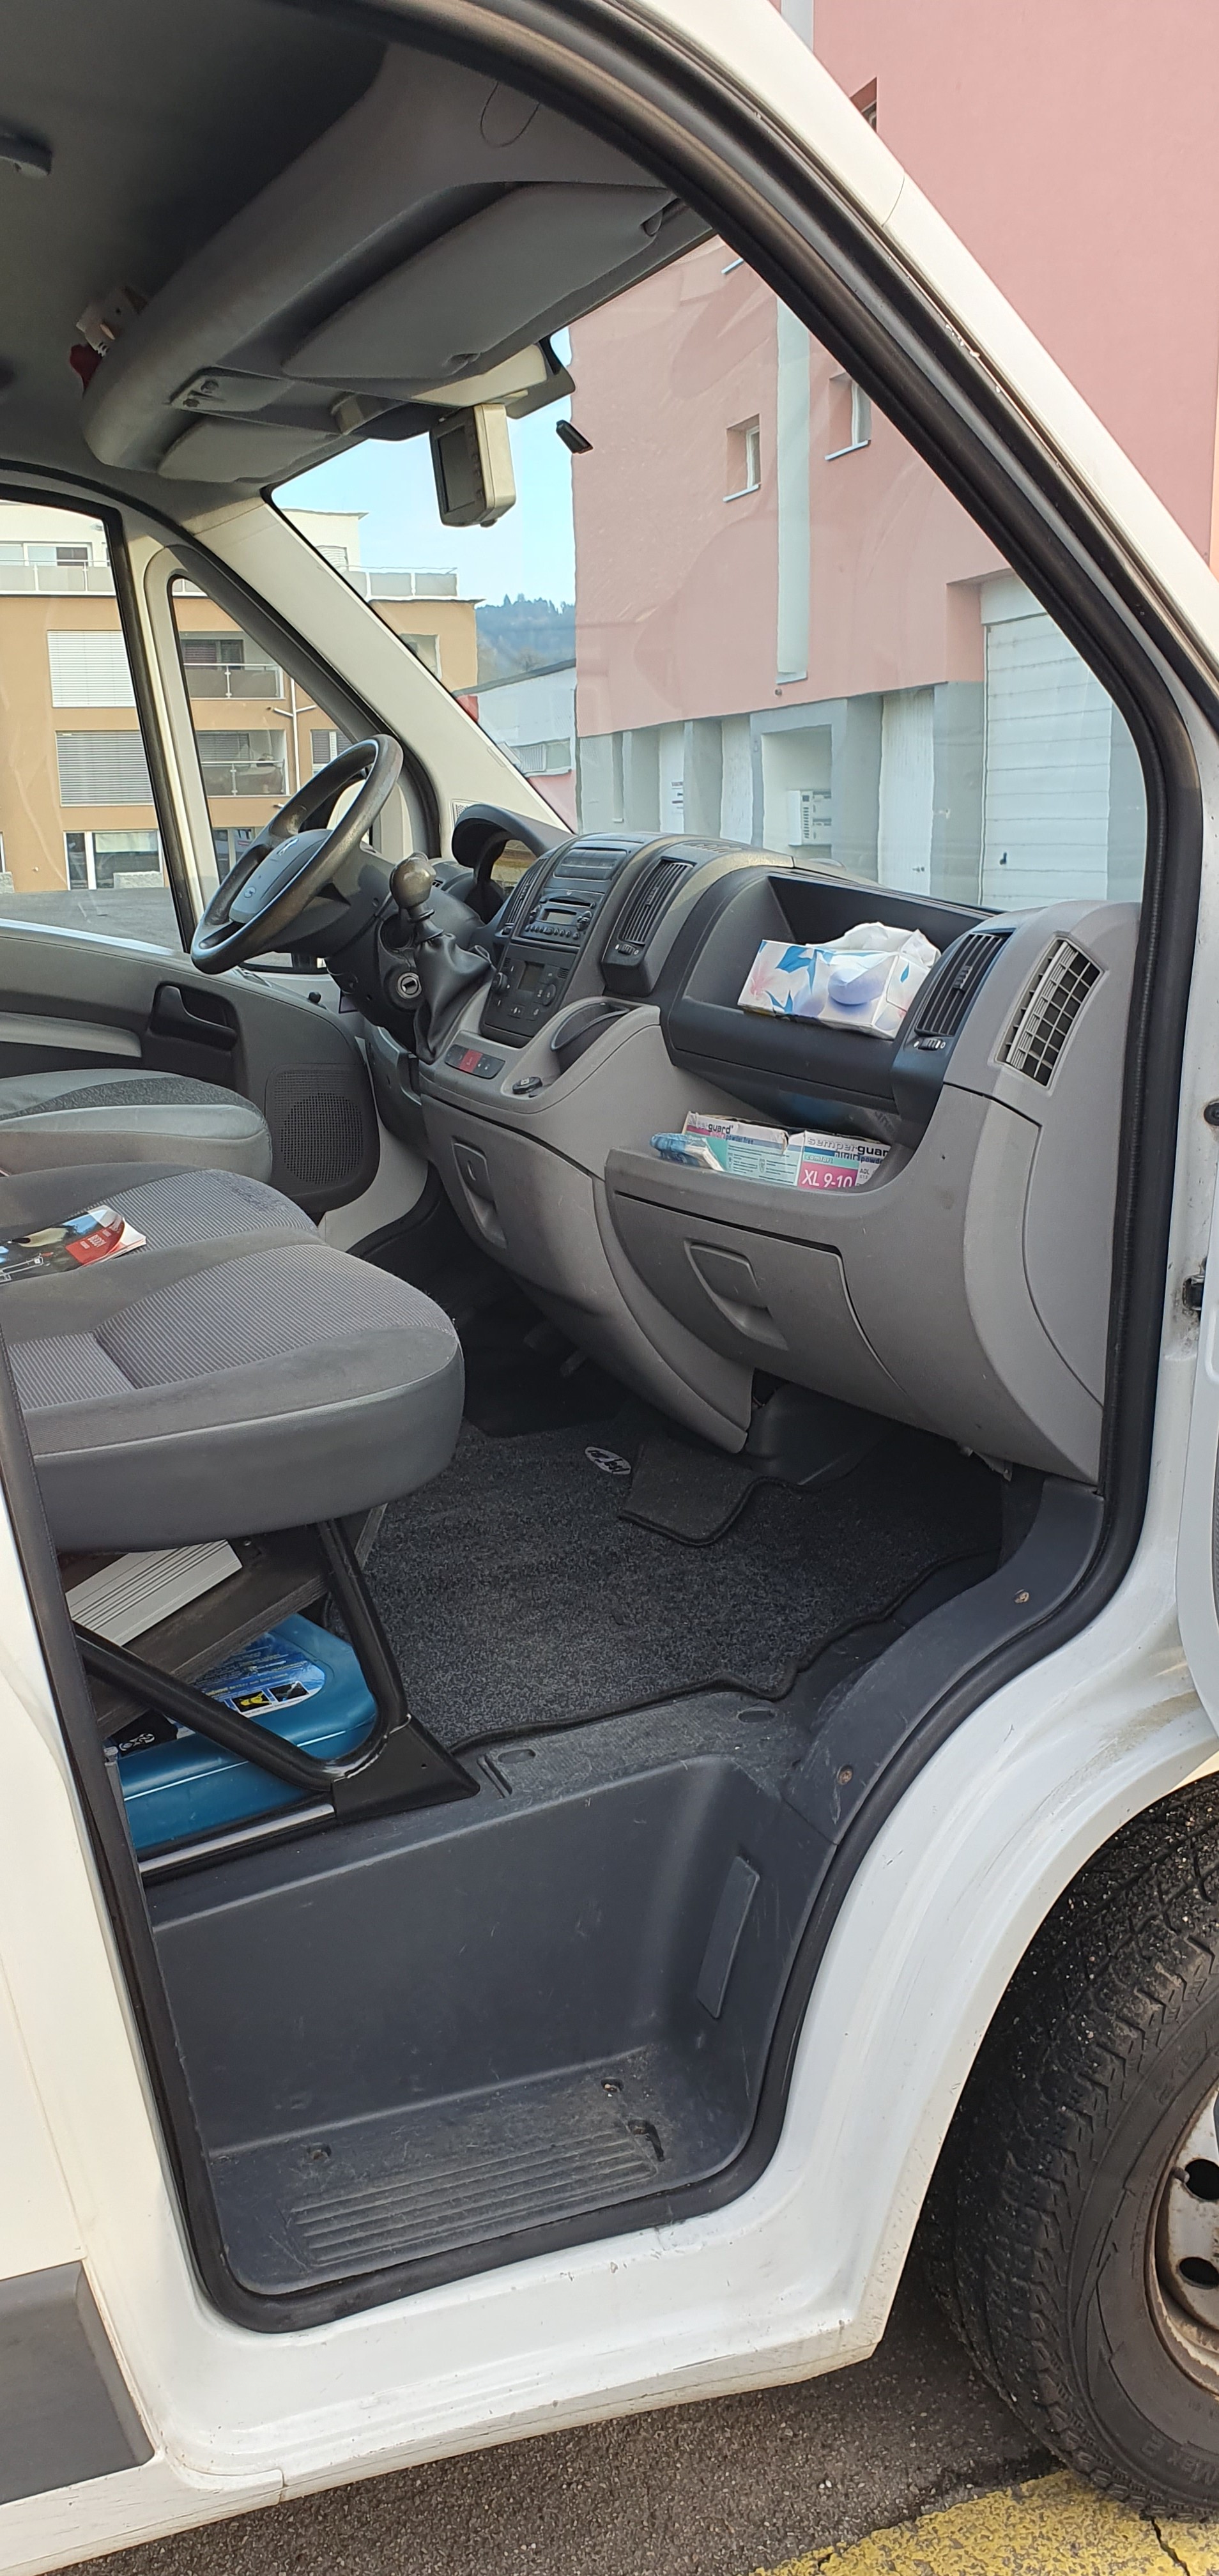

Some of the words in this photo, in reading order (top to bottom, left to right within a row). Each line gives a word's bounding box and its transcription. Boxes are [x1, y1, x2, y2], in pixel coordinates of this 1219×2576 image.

[808, 1137, 890, 1157] semperguar
[802, 1169, 820, 1186] XL
[824, 1173, 853, 1188] 9-10
